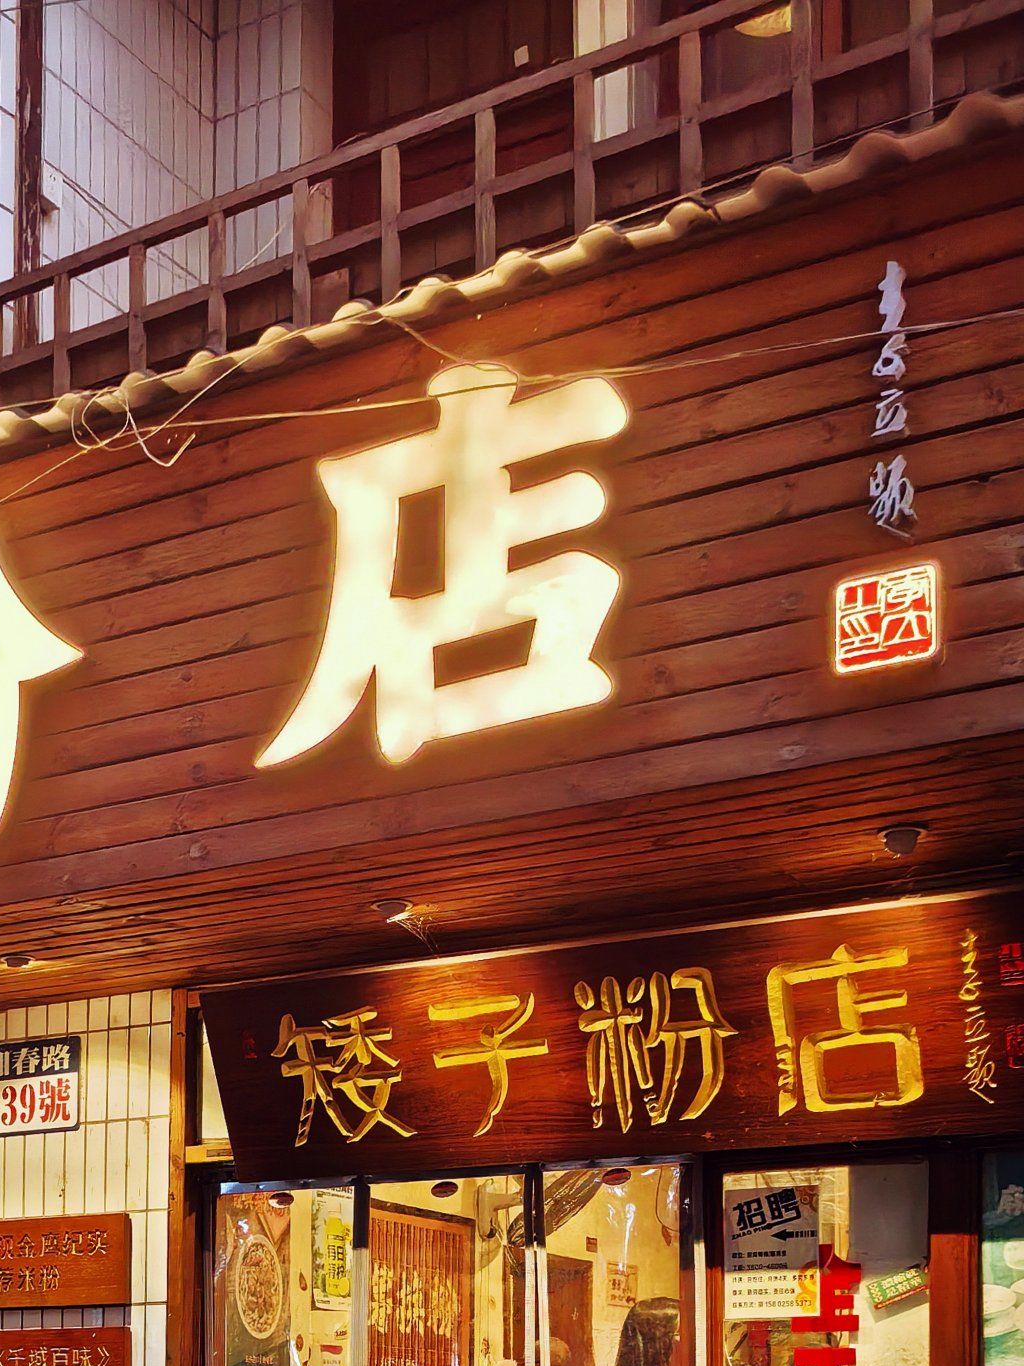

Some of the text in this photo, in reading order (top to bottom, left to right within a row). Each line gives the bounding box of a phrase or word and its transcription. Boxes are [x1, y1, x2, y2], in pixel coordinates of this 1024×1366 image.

[272, 944, 925, 1147] 矮子粉店
[732, 1187, 802, 1232] 招聘
